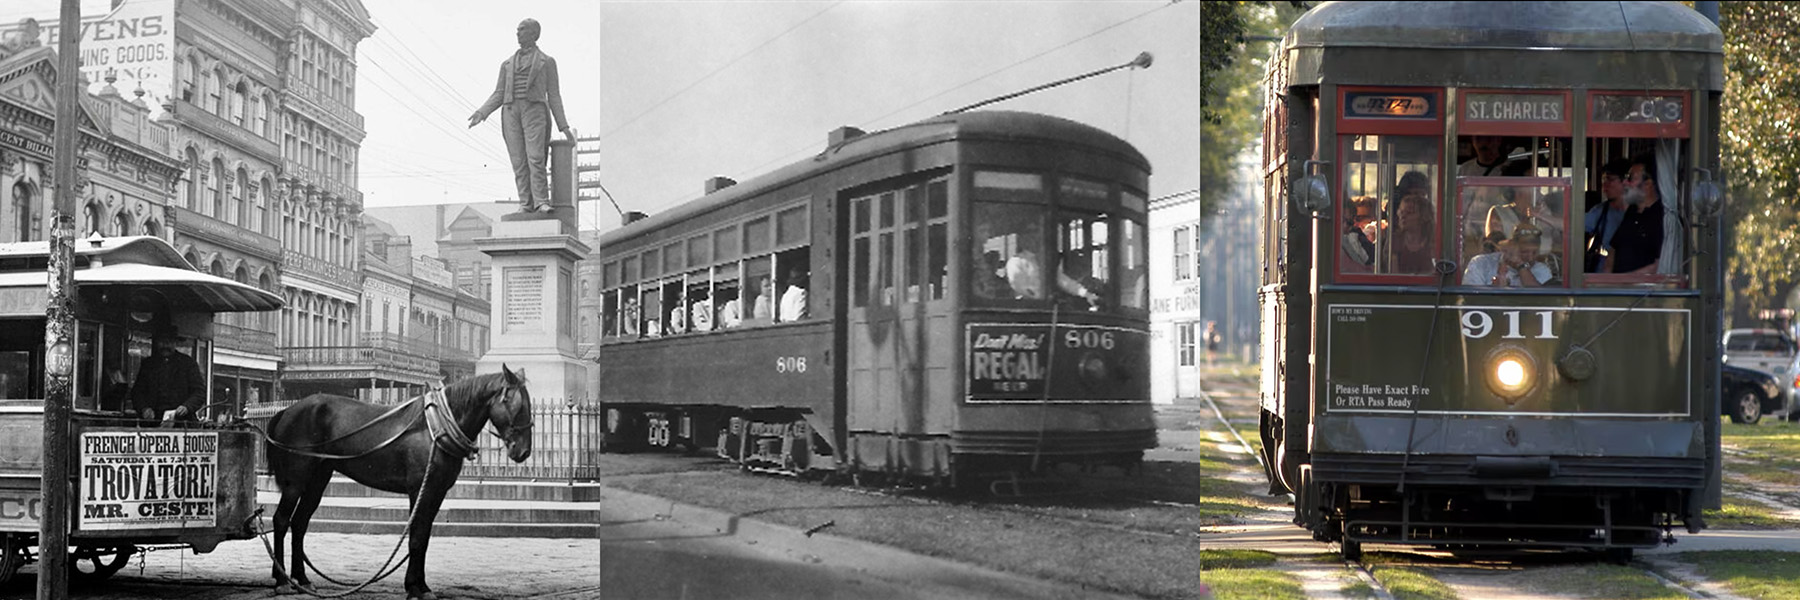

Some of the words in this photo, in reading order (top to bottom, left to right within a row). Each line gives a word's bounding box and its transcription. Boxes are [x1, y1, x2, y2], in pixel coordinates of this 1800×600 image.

[116, 43, 169, 64] GOODS.
[1469, 101, 1489, 119] ST.
[1493, 101, 1559, 120] CHARLES
[285, 160, 320, 186] MUSEUM
[1462, 310, 1559, 339] 911
[1065, 330, 1115, 350] 806
[776, 356, 807, 374] 806
[974, 352, 1045, 380] REGAL
[1335, 384, 1360, 395] Please
[1362, 384, 1382, 395] Have
[1385, 384, 1409, 395] Exact
[1335, 396, 1346, 406] Or
[1348, 396, 1365, 407] RTA
[1368, 396, 1385, 407] Pass
[1387, 397, 1412, 409] Ready
[84, 435, 137, 454] FRENCH
[139, 435, 180, 454] OPERA
[182, 434, 216, 453] HOUSE
[84, 464, 216, 501] TROVATORE!
[84, 503, 129, 519] MR.
[138, 501, 215, 517] CESTE!
